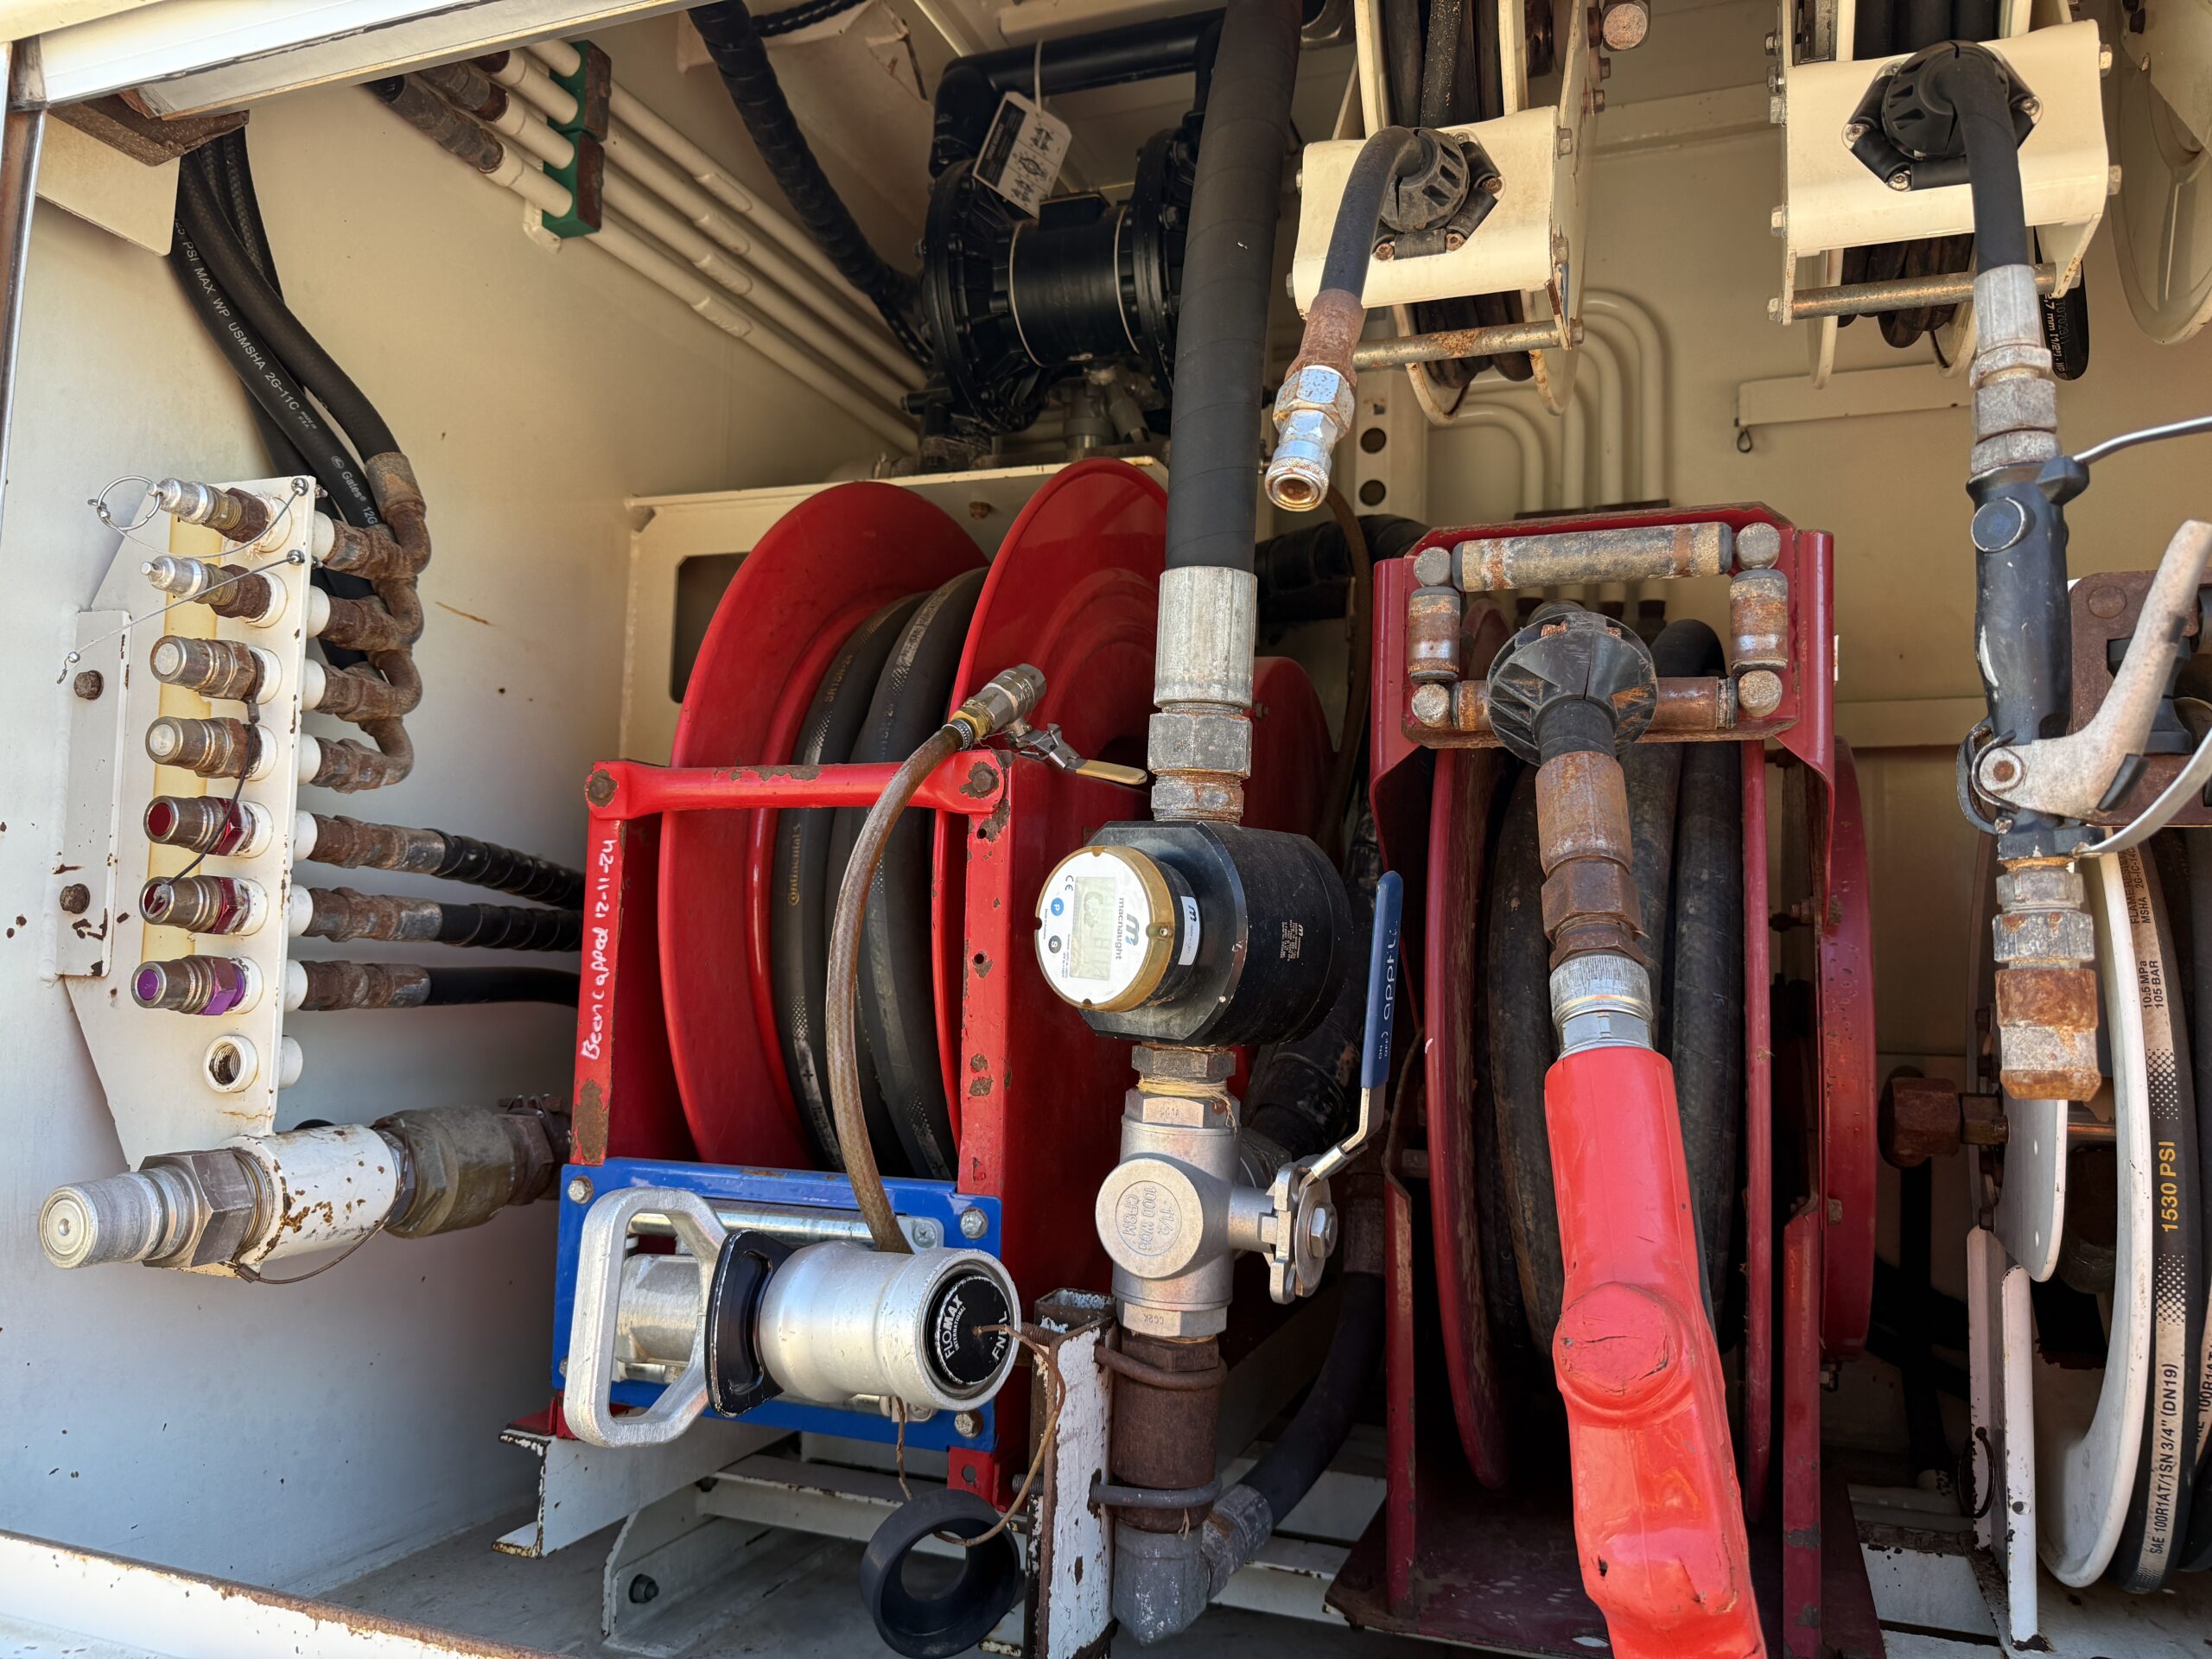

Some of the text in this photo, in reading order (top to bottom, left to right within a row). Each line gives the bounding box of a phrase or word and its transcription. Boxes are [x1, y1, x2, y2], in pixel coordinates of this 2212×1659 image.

[182, 241, 200, 262] PSI
[194, 267, 217, 295] MAX
[213, 297, 231, 318] WP
[228, 321, 267, 371] USMSHA
[264, 372, 300, 411] 2G-11C
[2047, 313, 2056, 331] mm
[361, 506, 378, 526] 12G
[1115, 897, 1125, 960] macnaught
[2126, 886, 2140, 925] FLAME
[2139, 897, 2152, 924] MSHA
[2139, 960, 2152, 988] MPa
[2149, 960, 2164, 1009] 105 BAR
[2158, 1141, 2180, 1233] 1530 PSI
[1122, 1193, 1140, 1236] CF8M
[1138, 1185, 1157, 1252] 1000 WOG
[942, 1294, 963, 1360] FLOMAX
[952, 1305, 966, 1351] INTERNATIONAL
[2149, 1535, 2166, 1554] SAE
[2160, 1363, 2179, 1417] (DN19)
